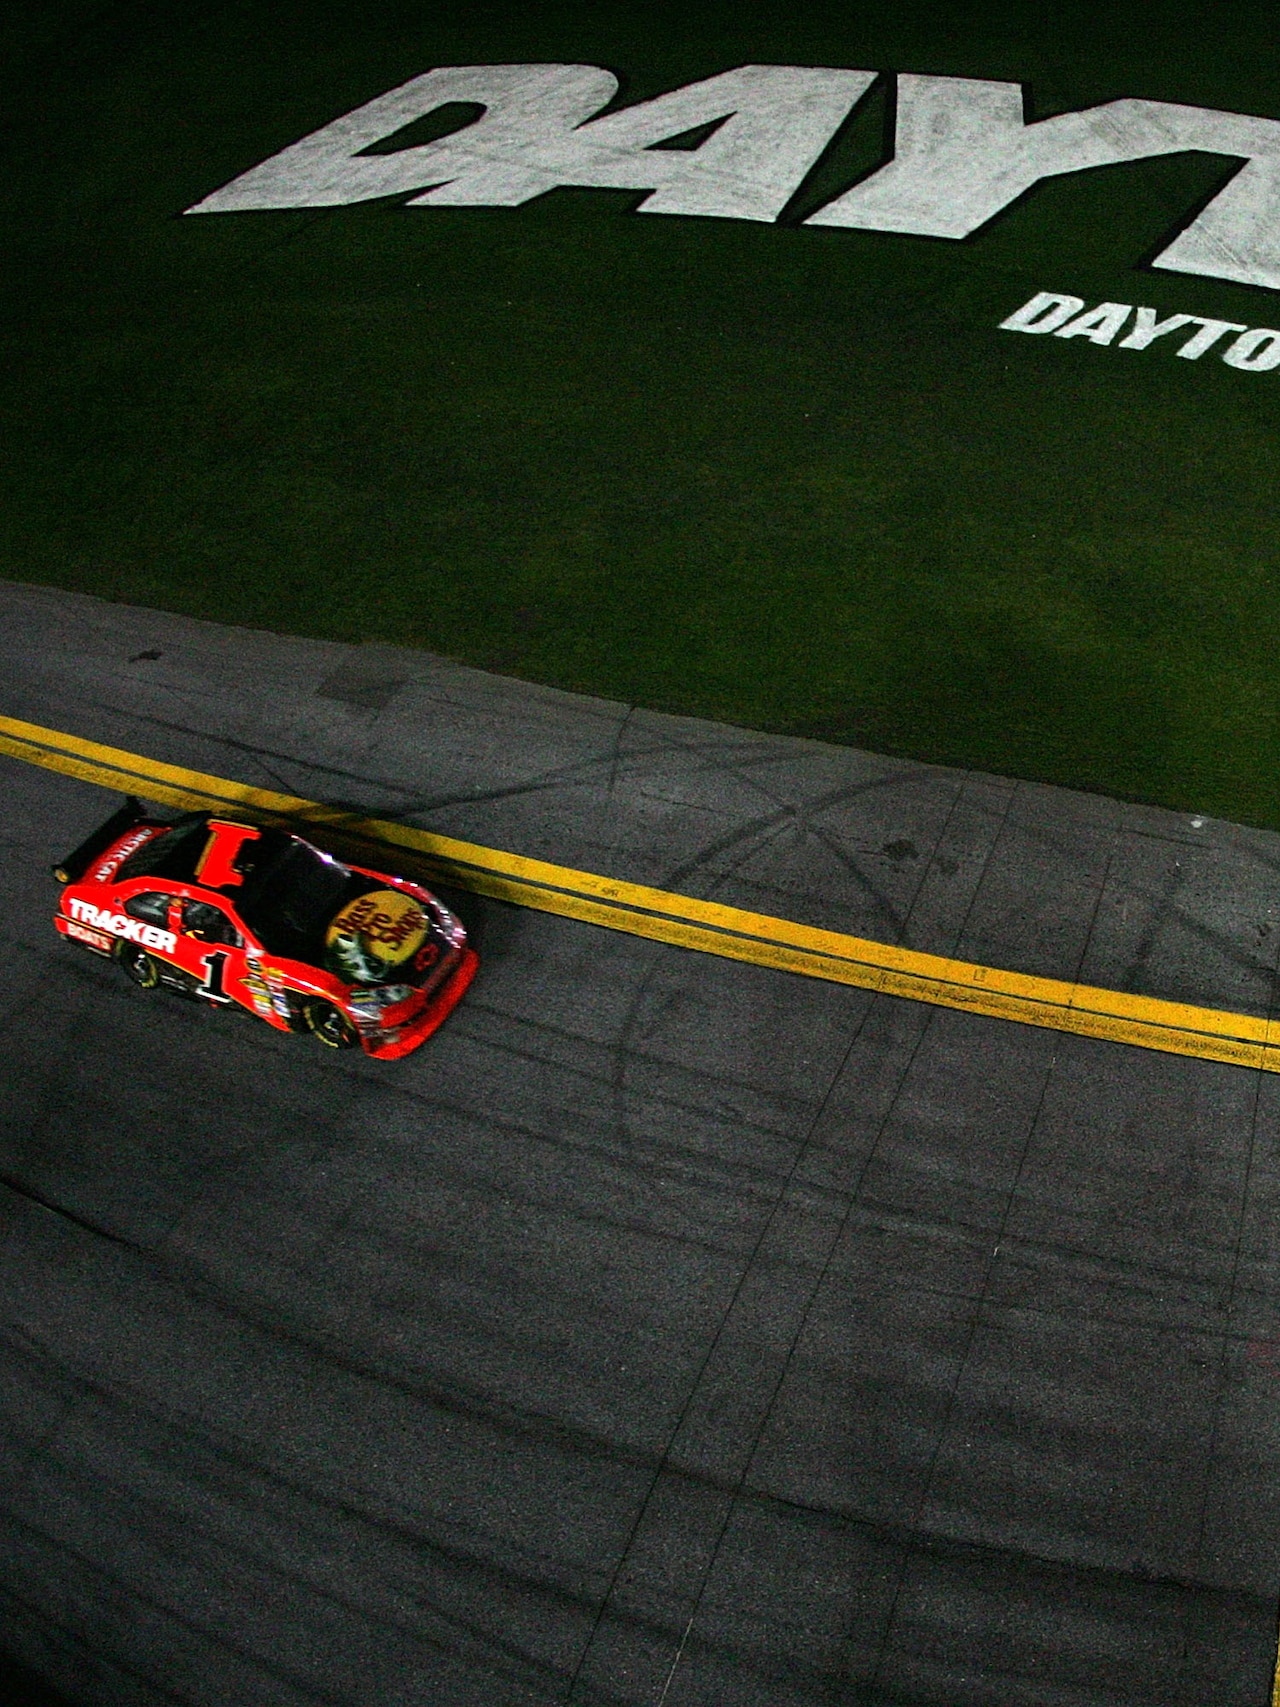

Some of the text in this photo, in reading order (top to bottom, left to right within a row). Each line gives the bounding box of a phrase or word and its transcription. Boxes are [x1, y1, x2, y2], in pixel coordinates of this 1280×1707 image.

[94, 860, 118, 882] CAT
[194, 818, 263, 889] 1
[66, 922, 112, 951] BOATS
[69, 898, 179, 954] TRACKER
[335, 899, 378, 934] Bass
[195, 950, 231, 1004] 1
